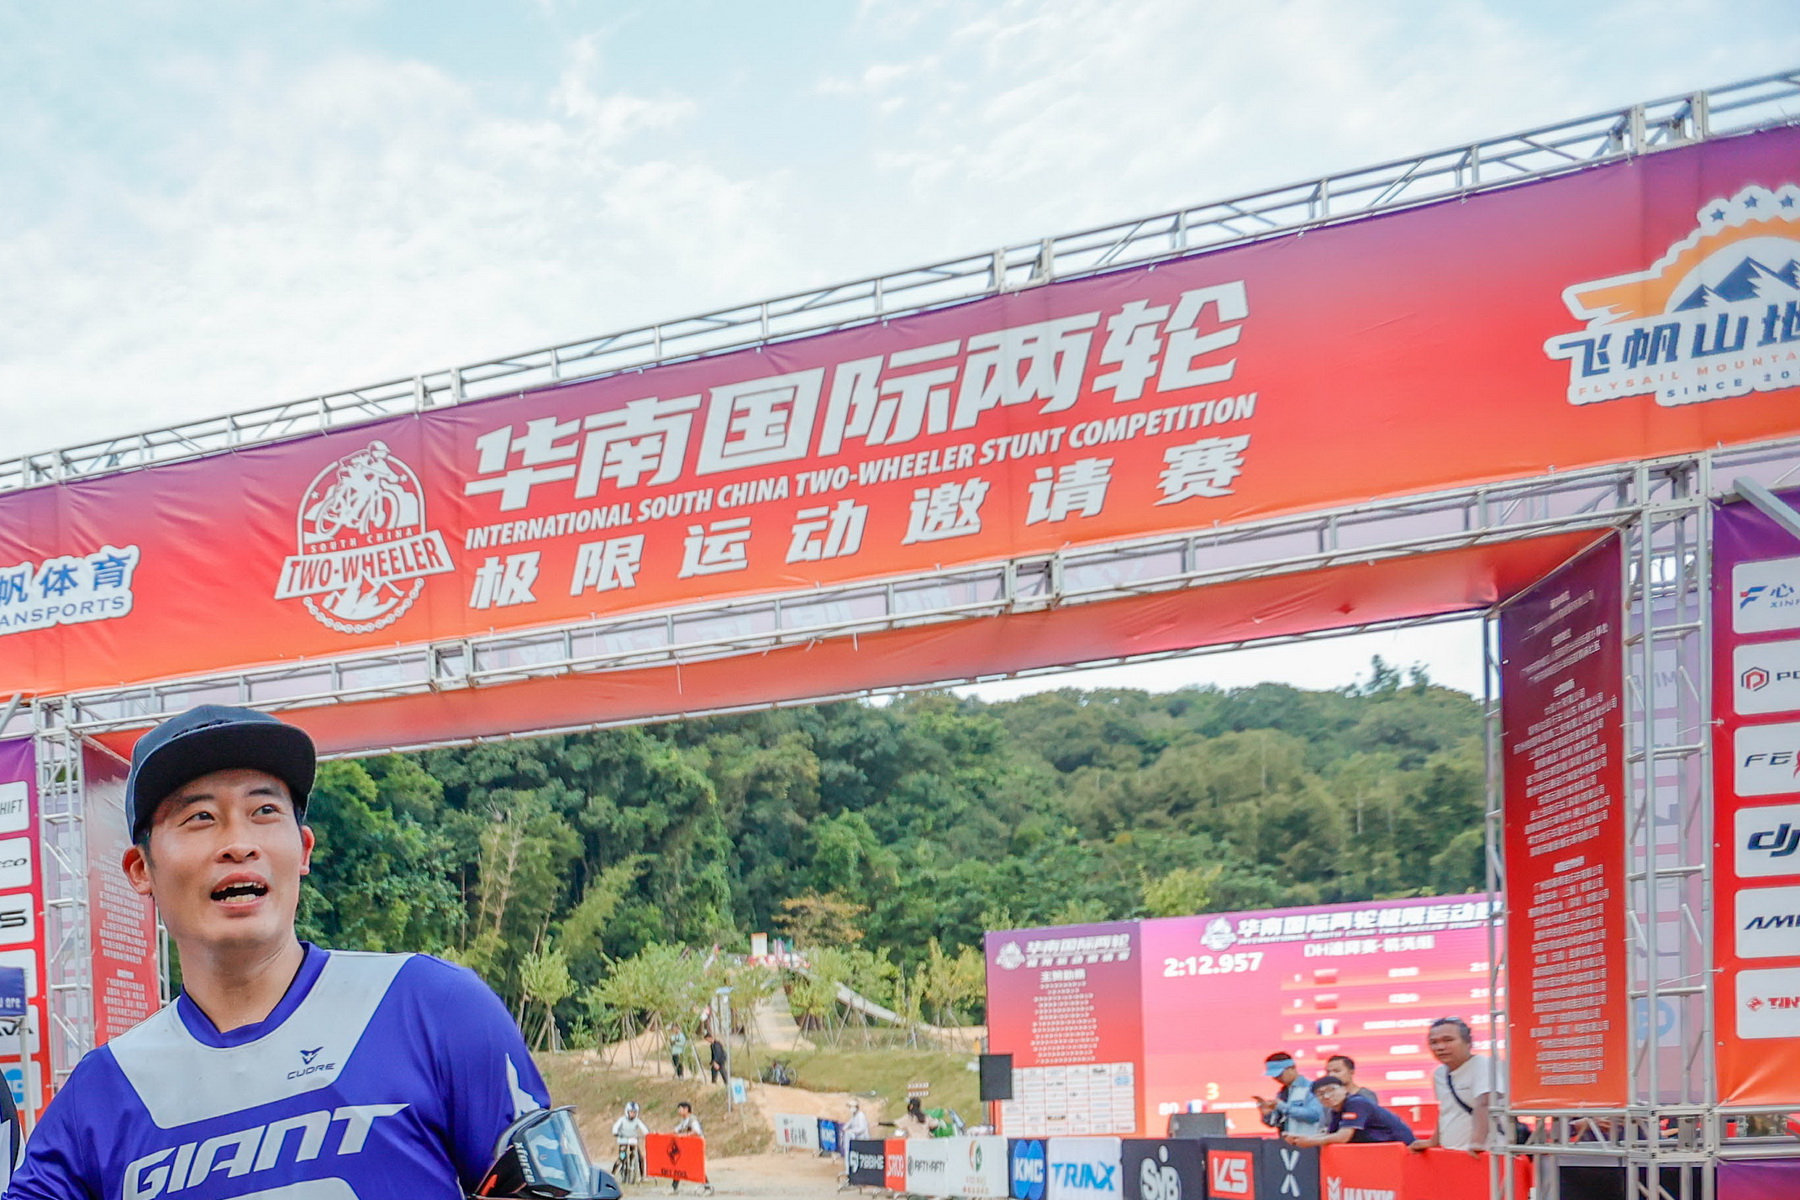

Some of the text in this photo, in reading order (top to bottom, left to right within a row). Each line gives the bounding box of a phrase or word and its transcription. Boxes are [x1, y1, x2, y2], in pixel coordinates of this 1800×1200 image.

[464, 280, 1248, 511] 华南国际两轮
[1578, 370, 1680, 397] FLYSAIL
[1666, 377, 1743, 398] SINCE
[464, 392, 1258, 549] INTERNATIONAL SOUTH CHINA TWO-WHEELER STUNT COMPETITION
[468, 434, 1254, 609] 极限运动邀请赛
[311, 526, 414, 554] SOUTH CHINA
[286, 536, 446, 593] TWO-WHEELER
[1163, 951, 1263, 978] 2:12.957
[6, 997, 21, 1009] are
[287, 1062, 336, 1080] CUORE
[1015, 1158, 1044, 1183] KMC
[1051, 1161, 1116, 1192] TRINX
